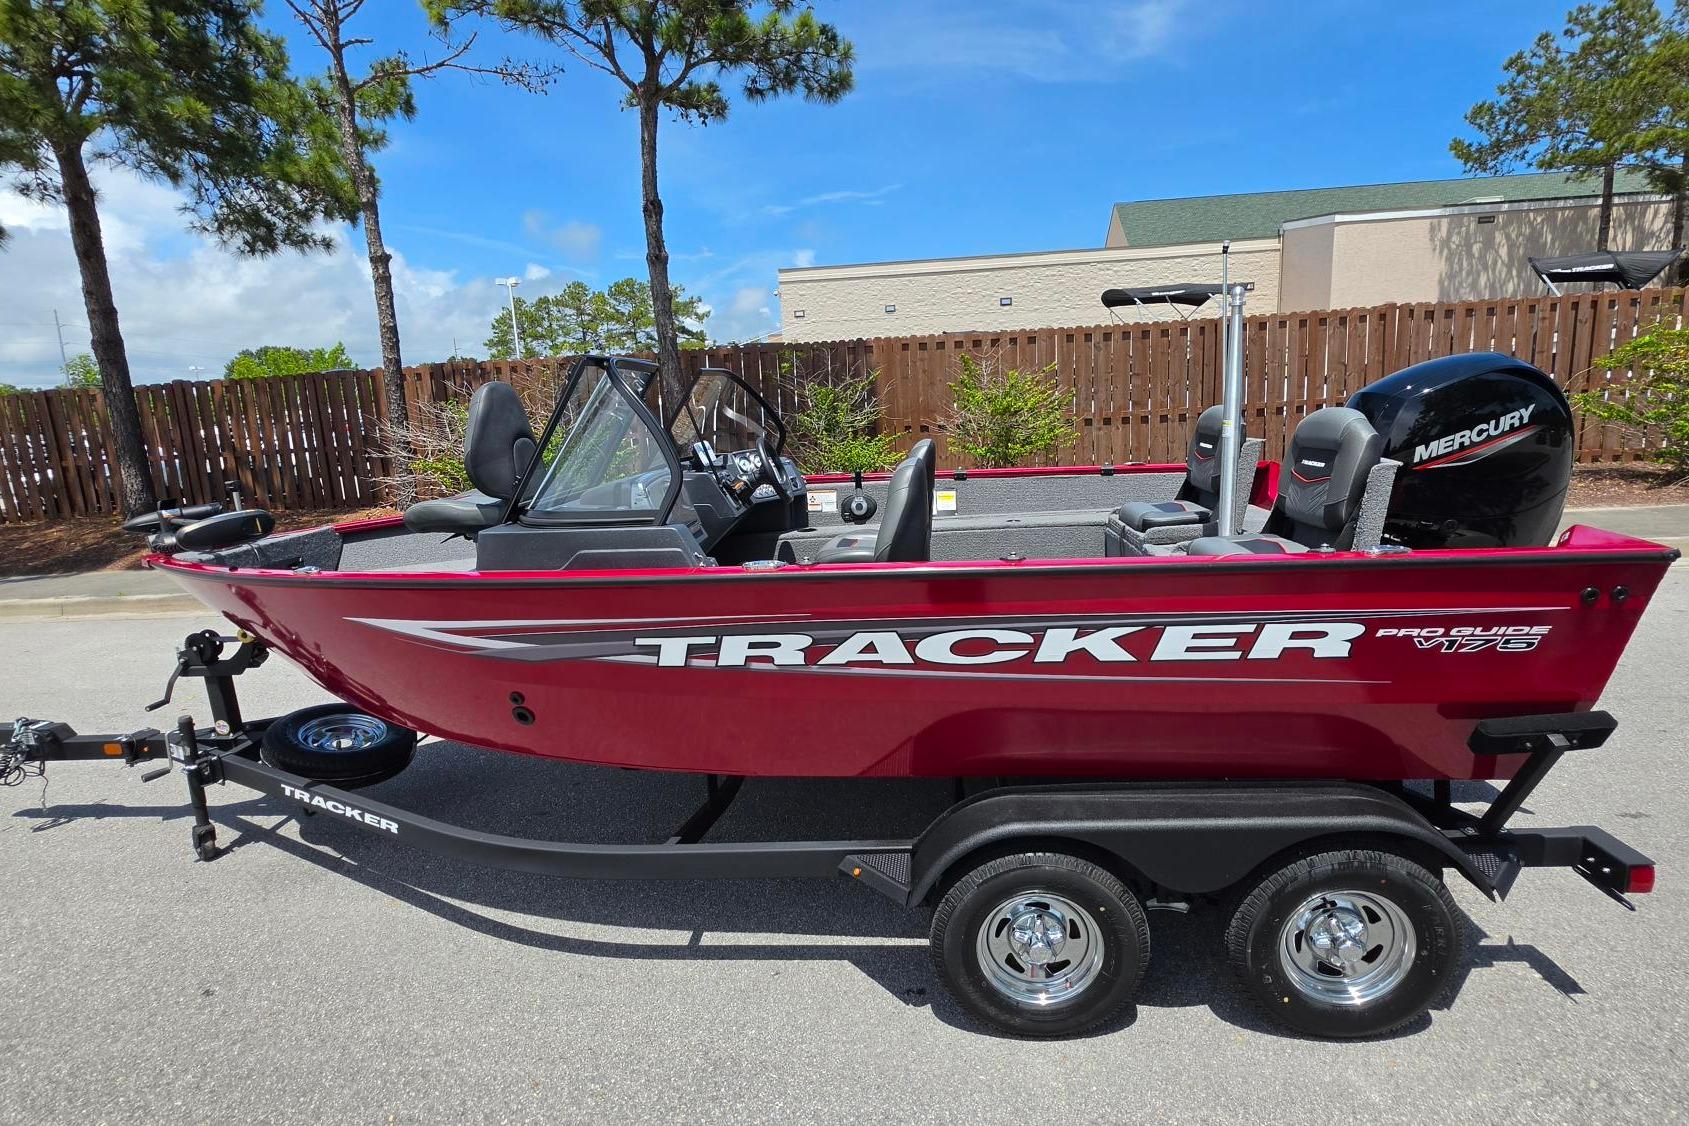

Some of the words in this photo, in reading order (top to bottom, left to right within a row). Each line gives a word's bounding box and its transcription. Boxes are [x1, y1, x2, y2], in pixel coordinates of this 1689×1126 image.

[1413, 403, 1536, 463] MERCURY
[633, 621, 1367, 668] TRACKER
[1375, 628, 1445, 637] PRO
[1449, 626, 1553, 636] GUIDE
[1413, 636, 1542, 653] V175
[280, 783, 399, 834] TRACKER
